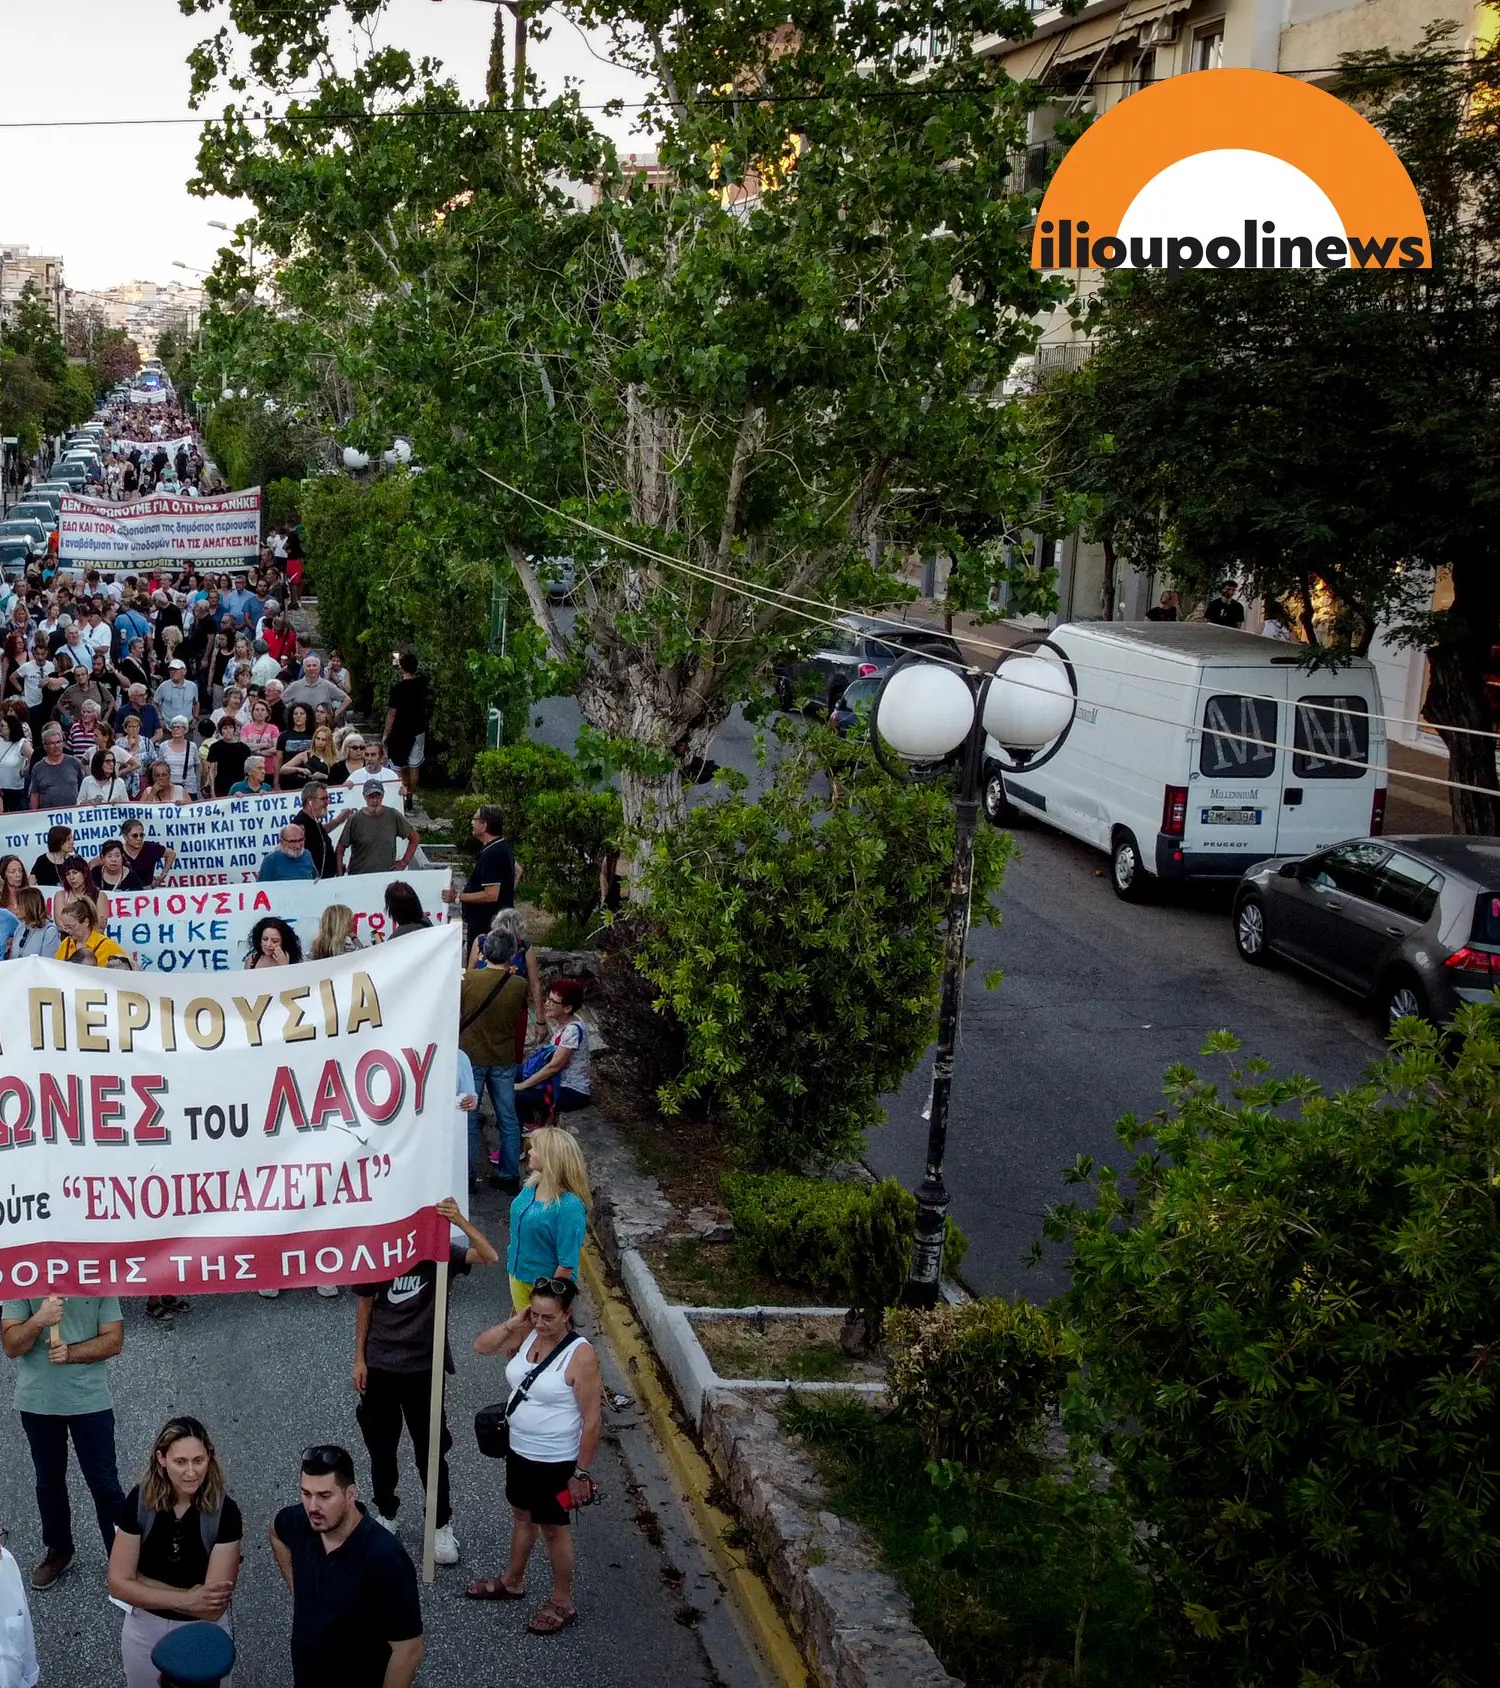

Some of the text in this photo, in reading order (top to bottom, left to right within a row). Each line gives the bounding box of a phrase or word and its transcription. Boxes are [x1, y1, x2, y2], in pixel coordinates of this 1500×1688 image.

[61, 499, 80, 511] ΔΕΝ
[154, 501, 169, 512] ΓΙΑ
[221, 497, 257, 510] ΑΝΗΚΕΙ
[62, 521, 77, 532] ΕΔΩ
[80, 522, 92, 532] ΚΑΙ
[94, 522, 116, 534] ΤΩΡΑ
[162, 524, 174, 534] της
[172, 539, 185, 548] ΓΙΑ
[187, 539, 200, 548] ΤΙΣ
[202, 537, 242, 548] ΑΝΑΓΚΕΣ
[244, 535, 257, 545] ΜΑΣ
[136, 559, 174, 567] ΦΟΡΕΙΣ
[177, 558, 244, 567] ΗΟΥΠΟΛΗΣ
[47, 812, 73, 826] ΤΟΝ
[79, 808, 152, 823] ΣΕΠΤΕΜΒΡΗ
[158, 807, 182, 819] ΤΟΥ
[189, 804, 225, 818] 1984,
[231, 801, 249, 814] ΜΕ
[255, 797, 288, 812] ΤΟΥΣ
[5, 834, 29, 848] ΤΟΥ
[148, 825, 160, 837] Δ.
[166, 822, 205, 836] ΚΙΝΤΗ
[211, 820, 234, 833] ΚΑΙ
[240, 817, 264, 831] ΤΟΥ
[181, 835, 256, 852] ΔΙΟΙΚΗΤΙΚΗ
[230, 853, 256, 867] ΑΠΟ
[157, 949, 230, 973] ΟΥΤΕ
[27, 971, 383, 1053] ΠΕΡΙΟΥΣΙΑ
[184, 1103, 249, 1141] του
[262, 1042, 437, 1137] ΛΑΟΥ
[170, 1253, 258, 1283] ΤΗΣ
[282, 1230, 418, 1276] ΠΟΛΗΣ
